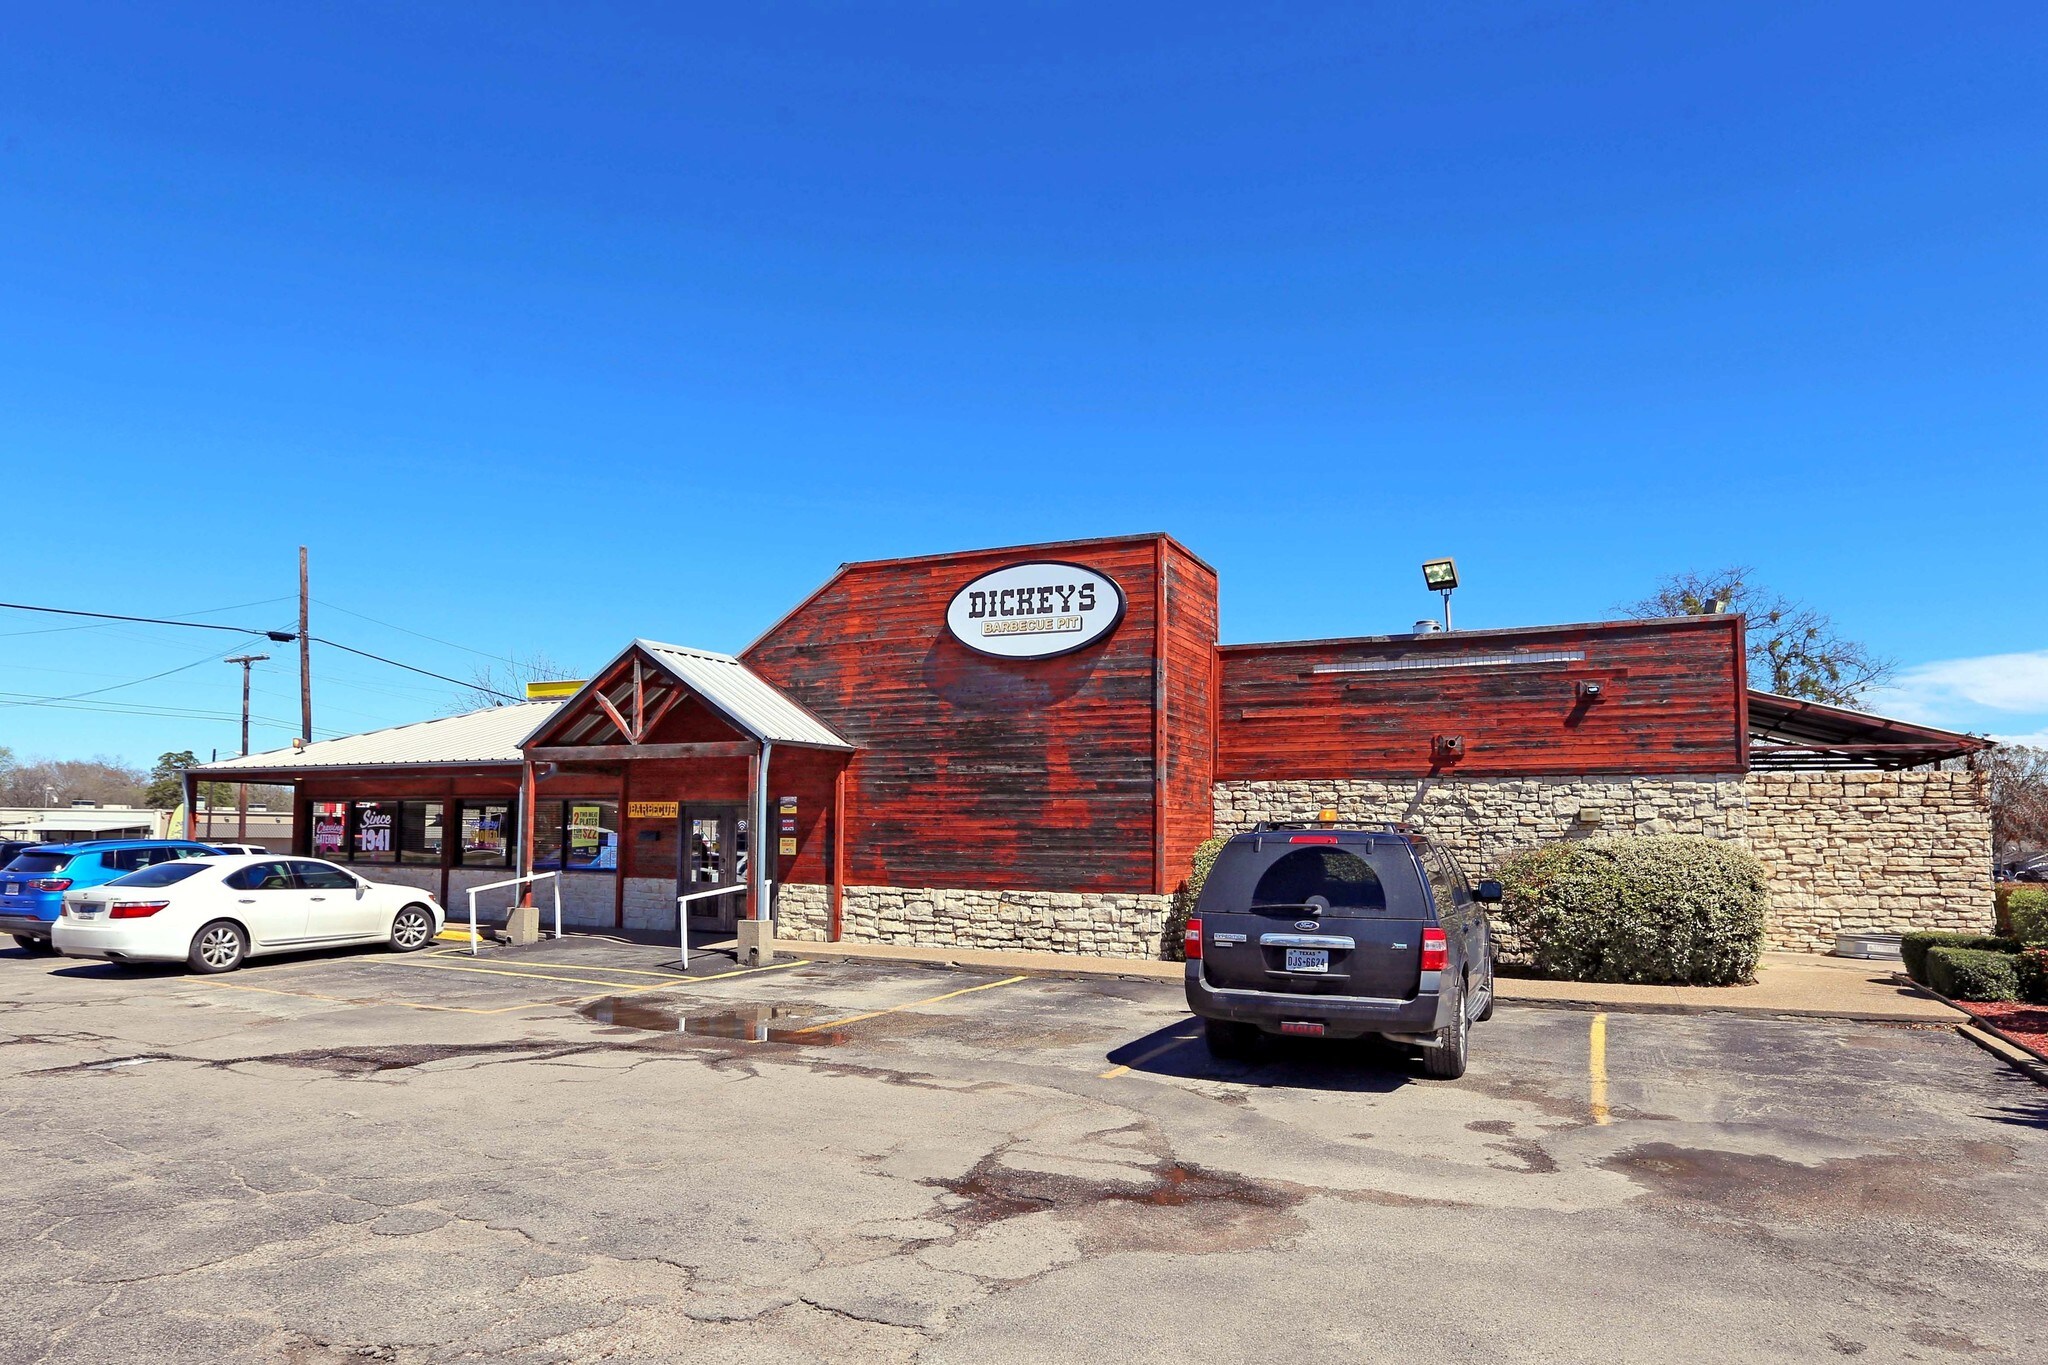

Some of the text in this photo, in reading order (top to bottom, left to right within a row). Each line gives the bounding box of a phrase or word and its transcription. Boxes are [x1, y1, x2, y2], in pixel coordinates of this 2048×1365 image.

[984, 617, 1079, 633] BARBECUE PIT
[629, 804, 677, 816] BARBECUE
[360, 810, 391, 829] Since
[580, 818, 598, 826] PLATES
[361, 829, 390, 851] 1941
[582, 828, 597, 840] $22
